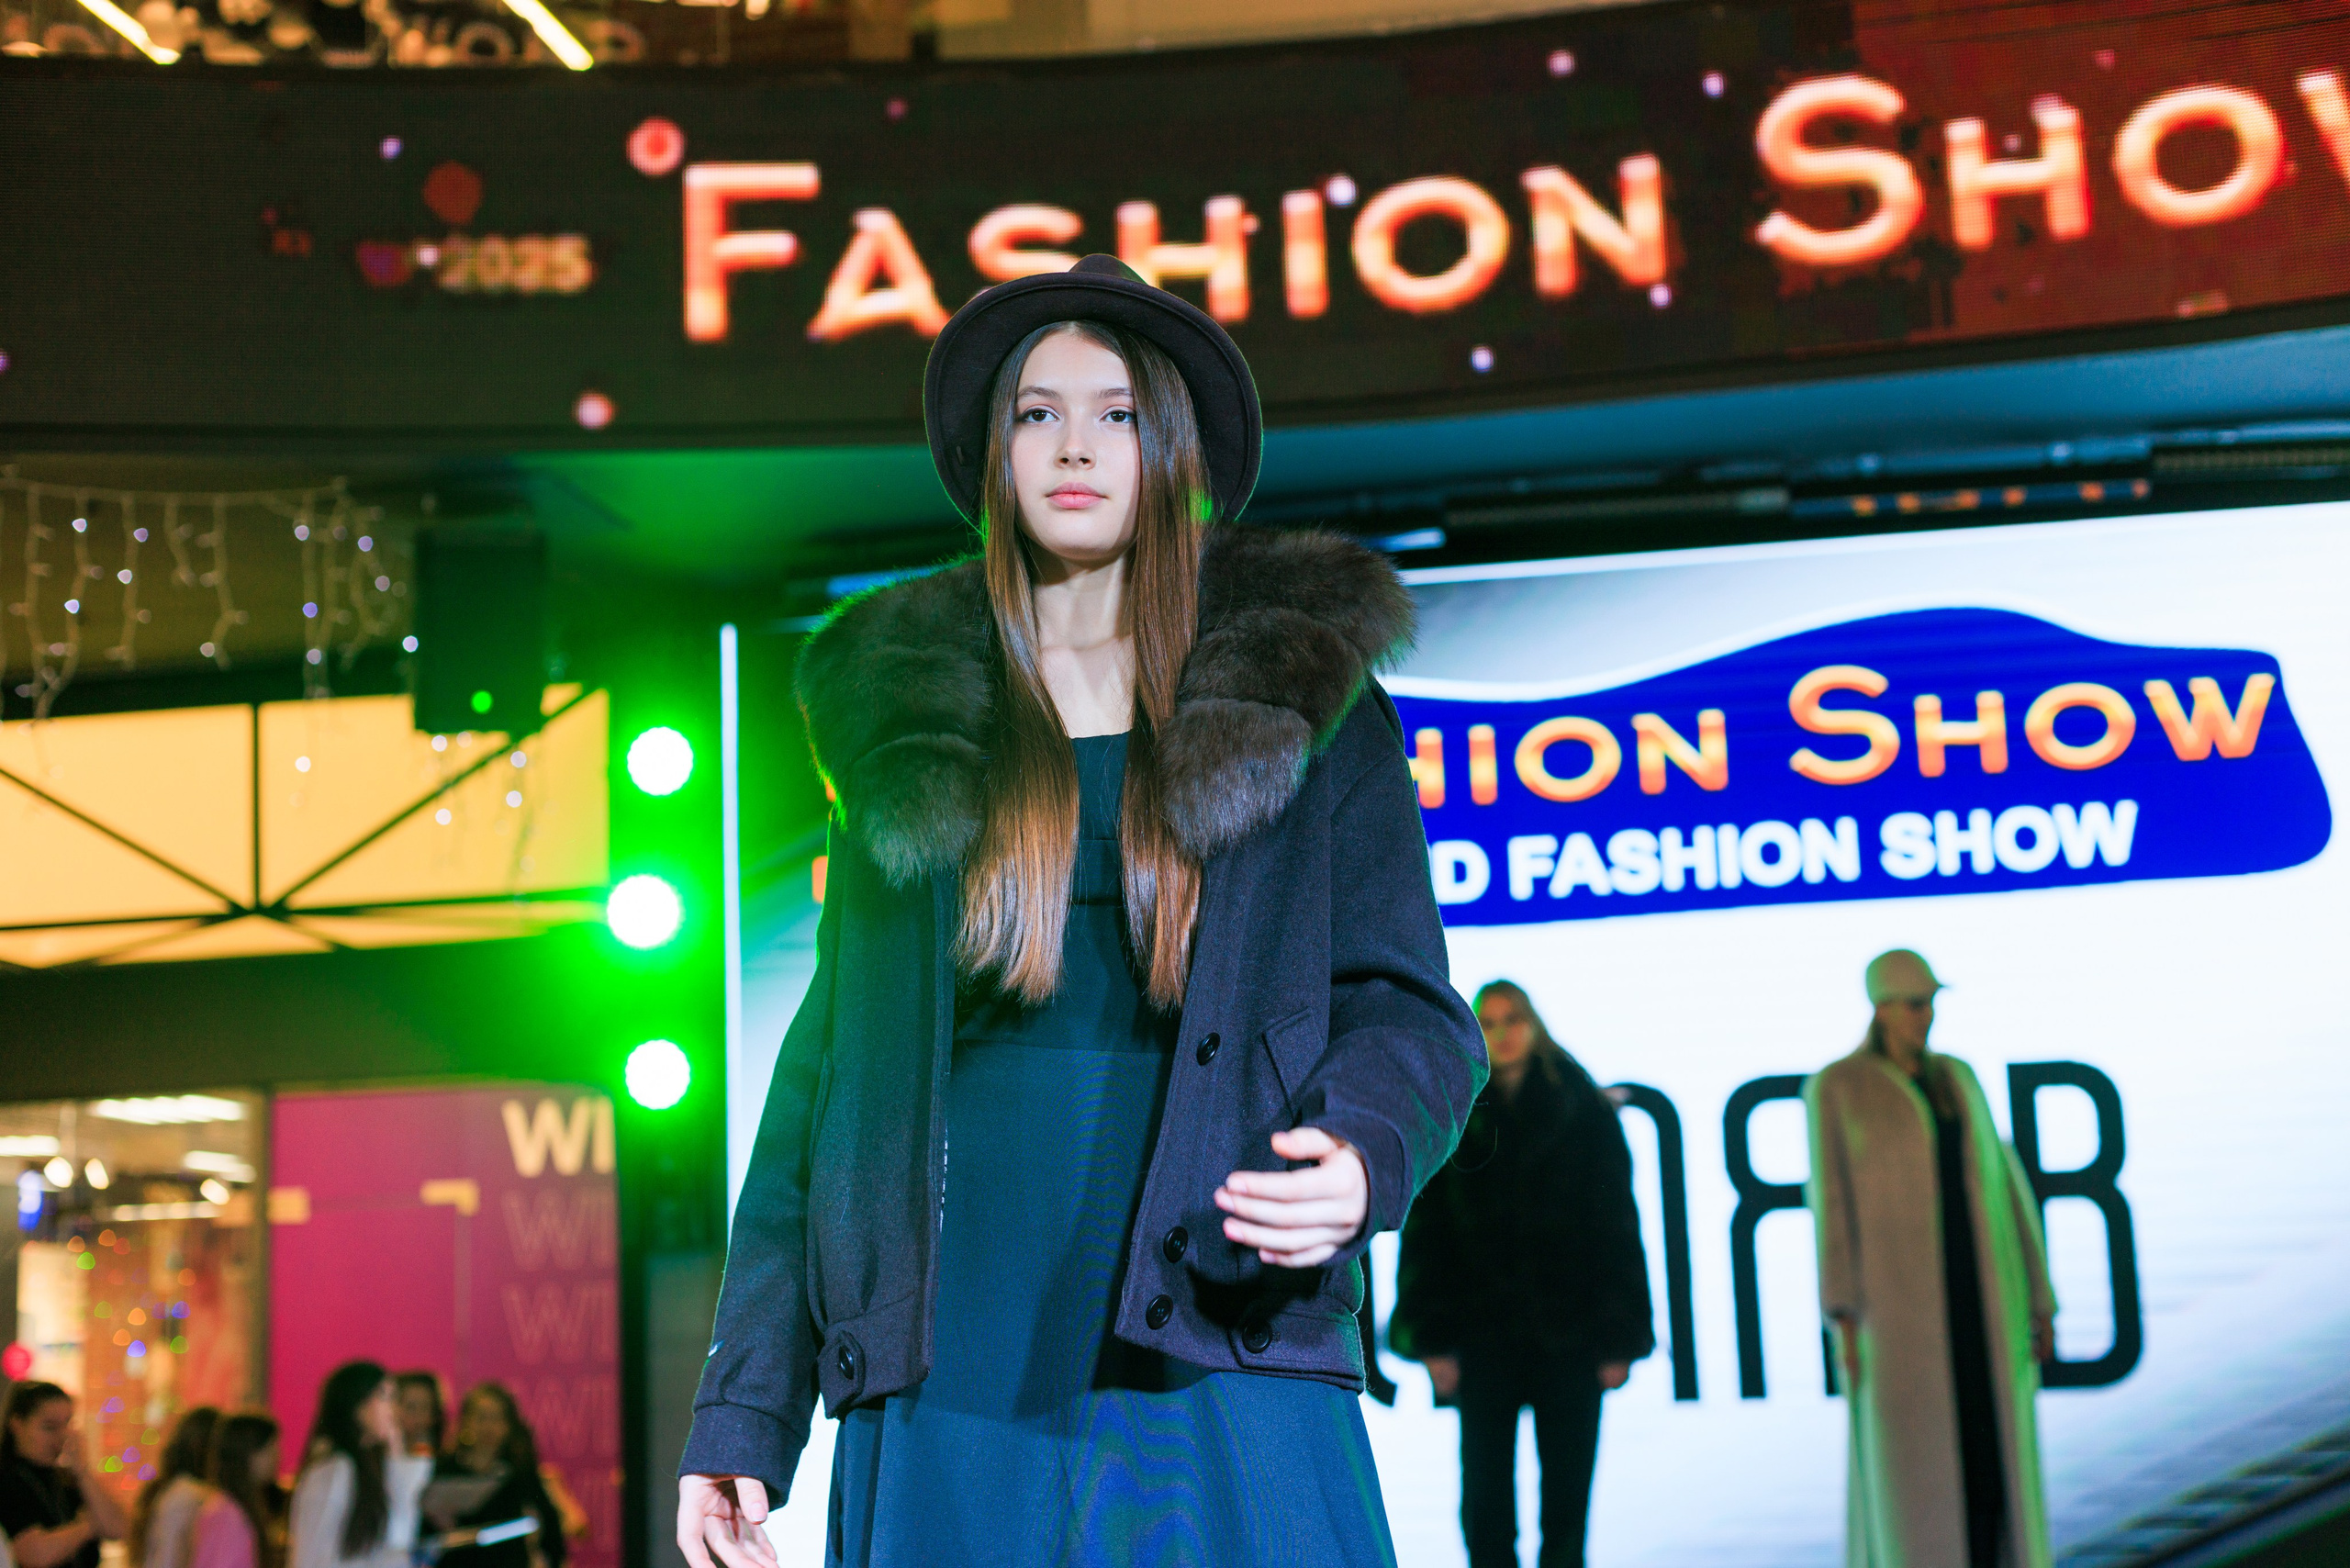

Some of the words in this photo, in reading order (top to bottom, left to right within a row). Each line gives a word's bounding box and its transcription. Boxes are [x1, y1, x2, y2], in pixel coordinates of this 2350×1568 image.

[1788, 665, 2276, 786] SHOW
[1506, 816, 1862, 901] FASHION
[1878, 800, 2139, 876] SHOW
